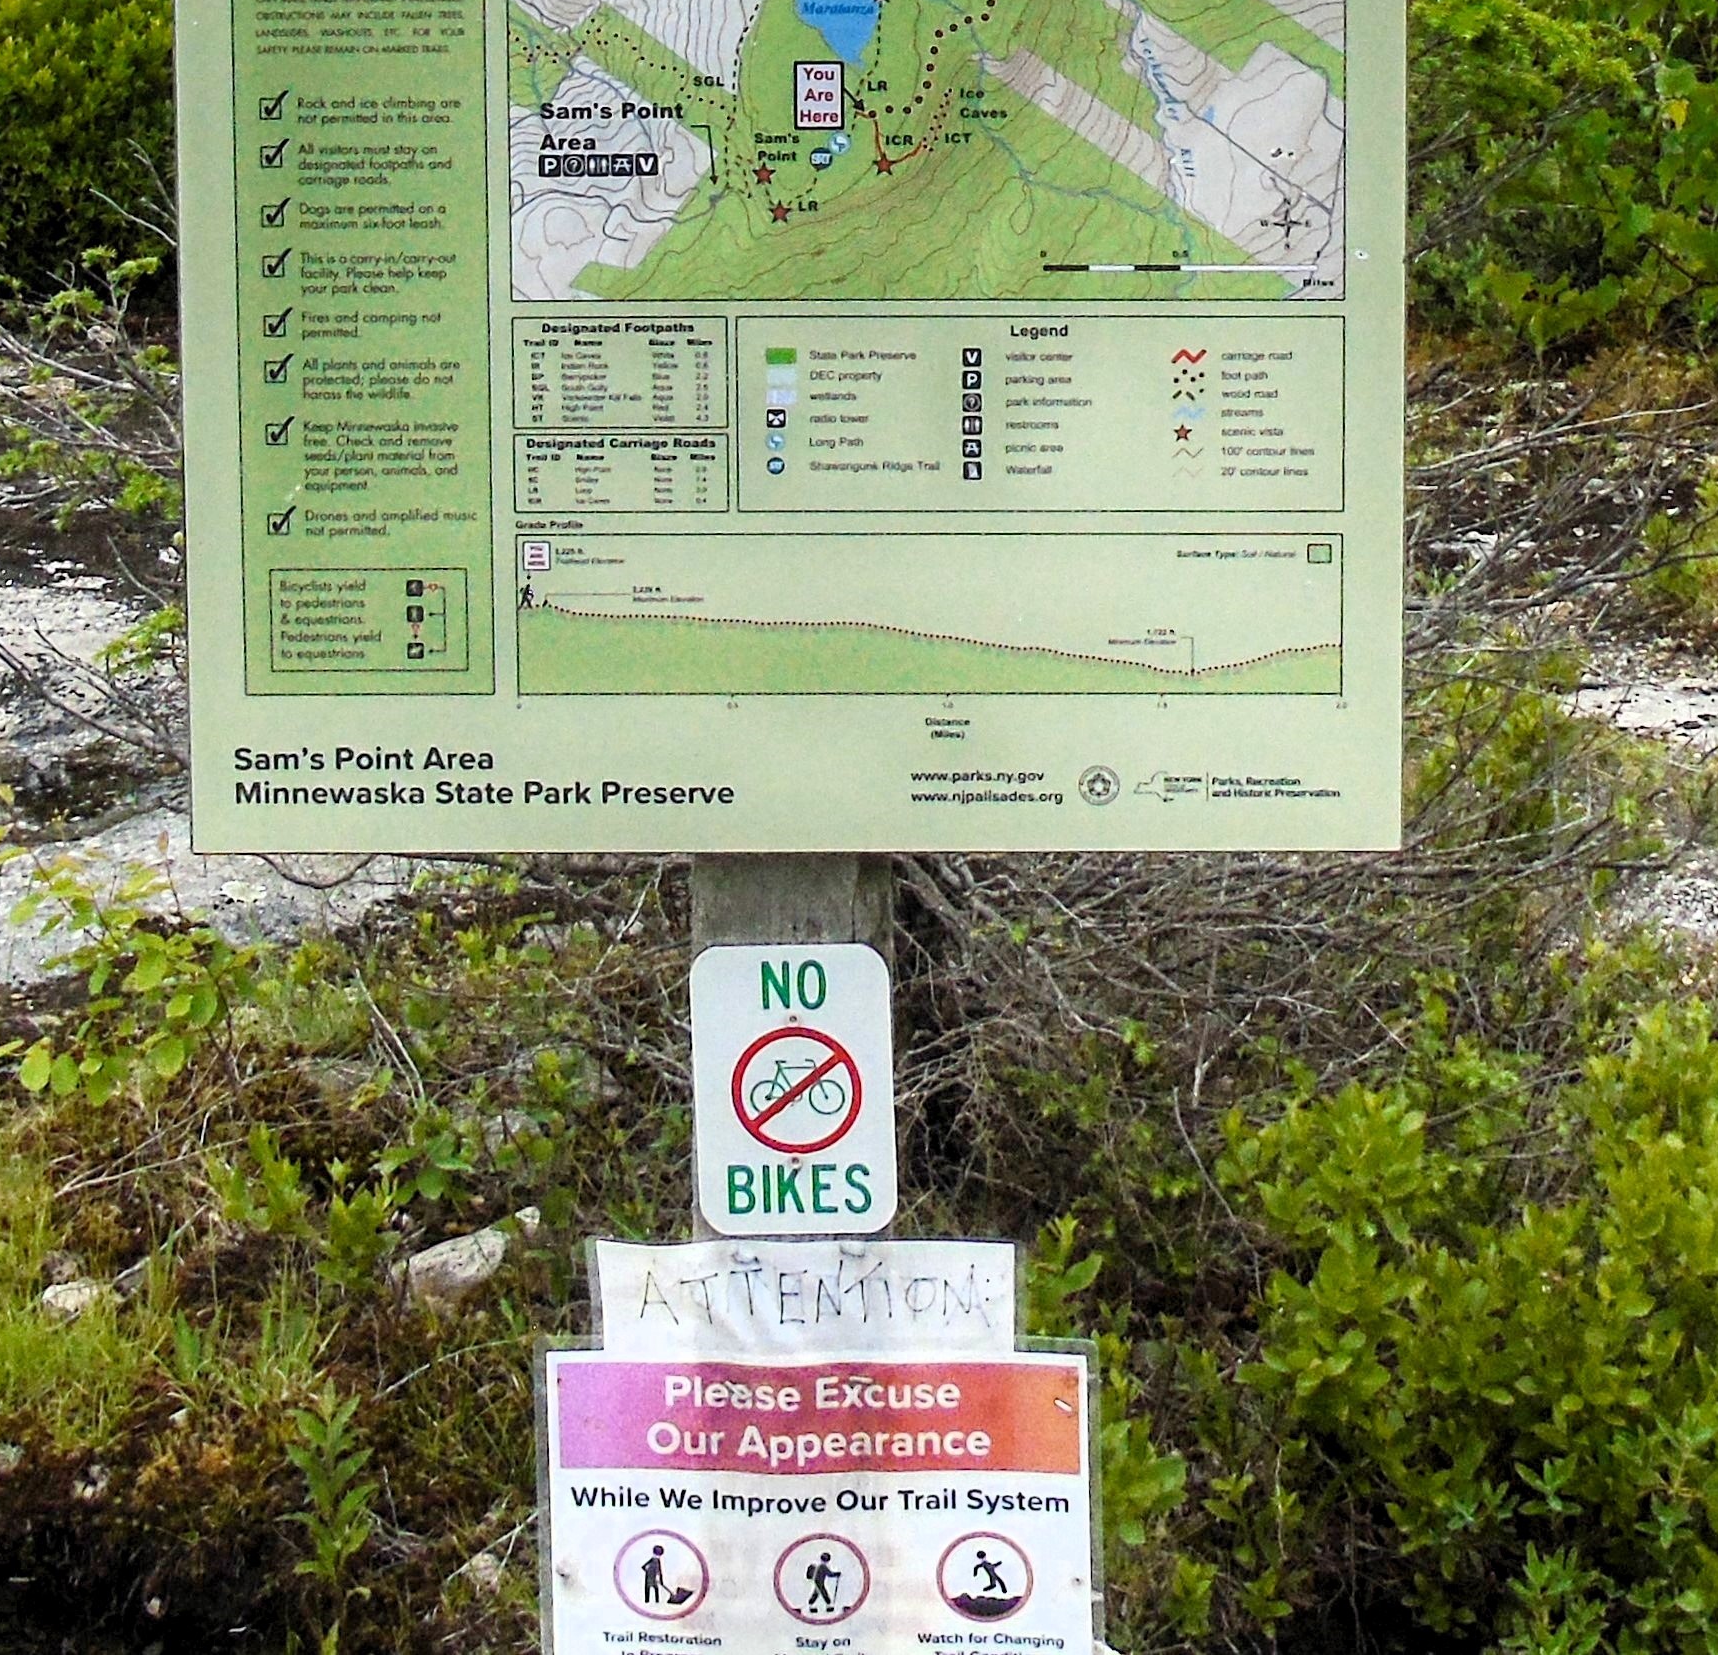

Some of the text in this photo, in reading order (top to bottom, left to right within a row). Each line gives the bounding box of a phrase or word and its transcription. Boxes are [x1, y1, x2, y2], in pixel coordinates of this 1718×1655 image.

[693, 75, 725, 88] SGL
[803, 67, 835, 81] You
[867, 80, 888, 92] LR
[959, 88, 985, 99] Ice
[804, 88, 834, 102] Are
[540, 100, 686, 120] Sam's Point
[800, 108, 840, 125] Here
[959, 106, 1008, 119] Caves
[539, 132, 596, 150] Area
[754, 132, 800, 144] Sam's
[885, 134, 914, 146] ICR
[945, 132, 973, 144] ICT
[757, 150, 797, 166] Point
[798, 200, 818, 212] LR
[541, 322, 694, 336] Designated Footpaths
[1010, 324, 1068, 340] Legend
[526, 438, 716, 451] Designated Carriage Roads
[335, 746, 414, 770] Point
[423, 747, 493, 770] Area
[910, 770, 1044, 784] www.parks.ny.gov
[235, 780, 734, 804] Minnewaska State Park Preserve
[761, 960, 827, 1010] NO
[727, 1160, 872, 1214] BIKES
[664, 1375, 962, 1413] Please Excuse
[646, 1420, 992, 1468] Our Appearance
[571, 1486, 1069, 1518] While We Improve Our Trail System
[603, 1631, 722, 1646] Trail Restoration
[795, 1636, 851, 1651] Stay on
[917, 1632, 1065, 1650] Watch for Changing
